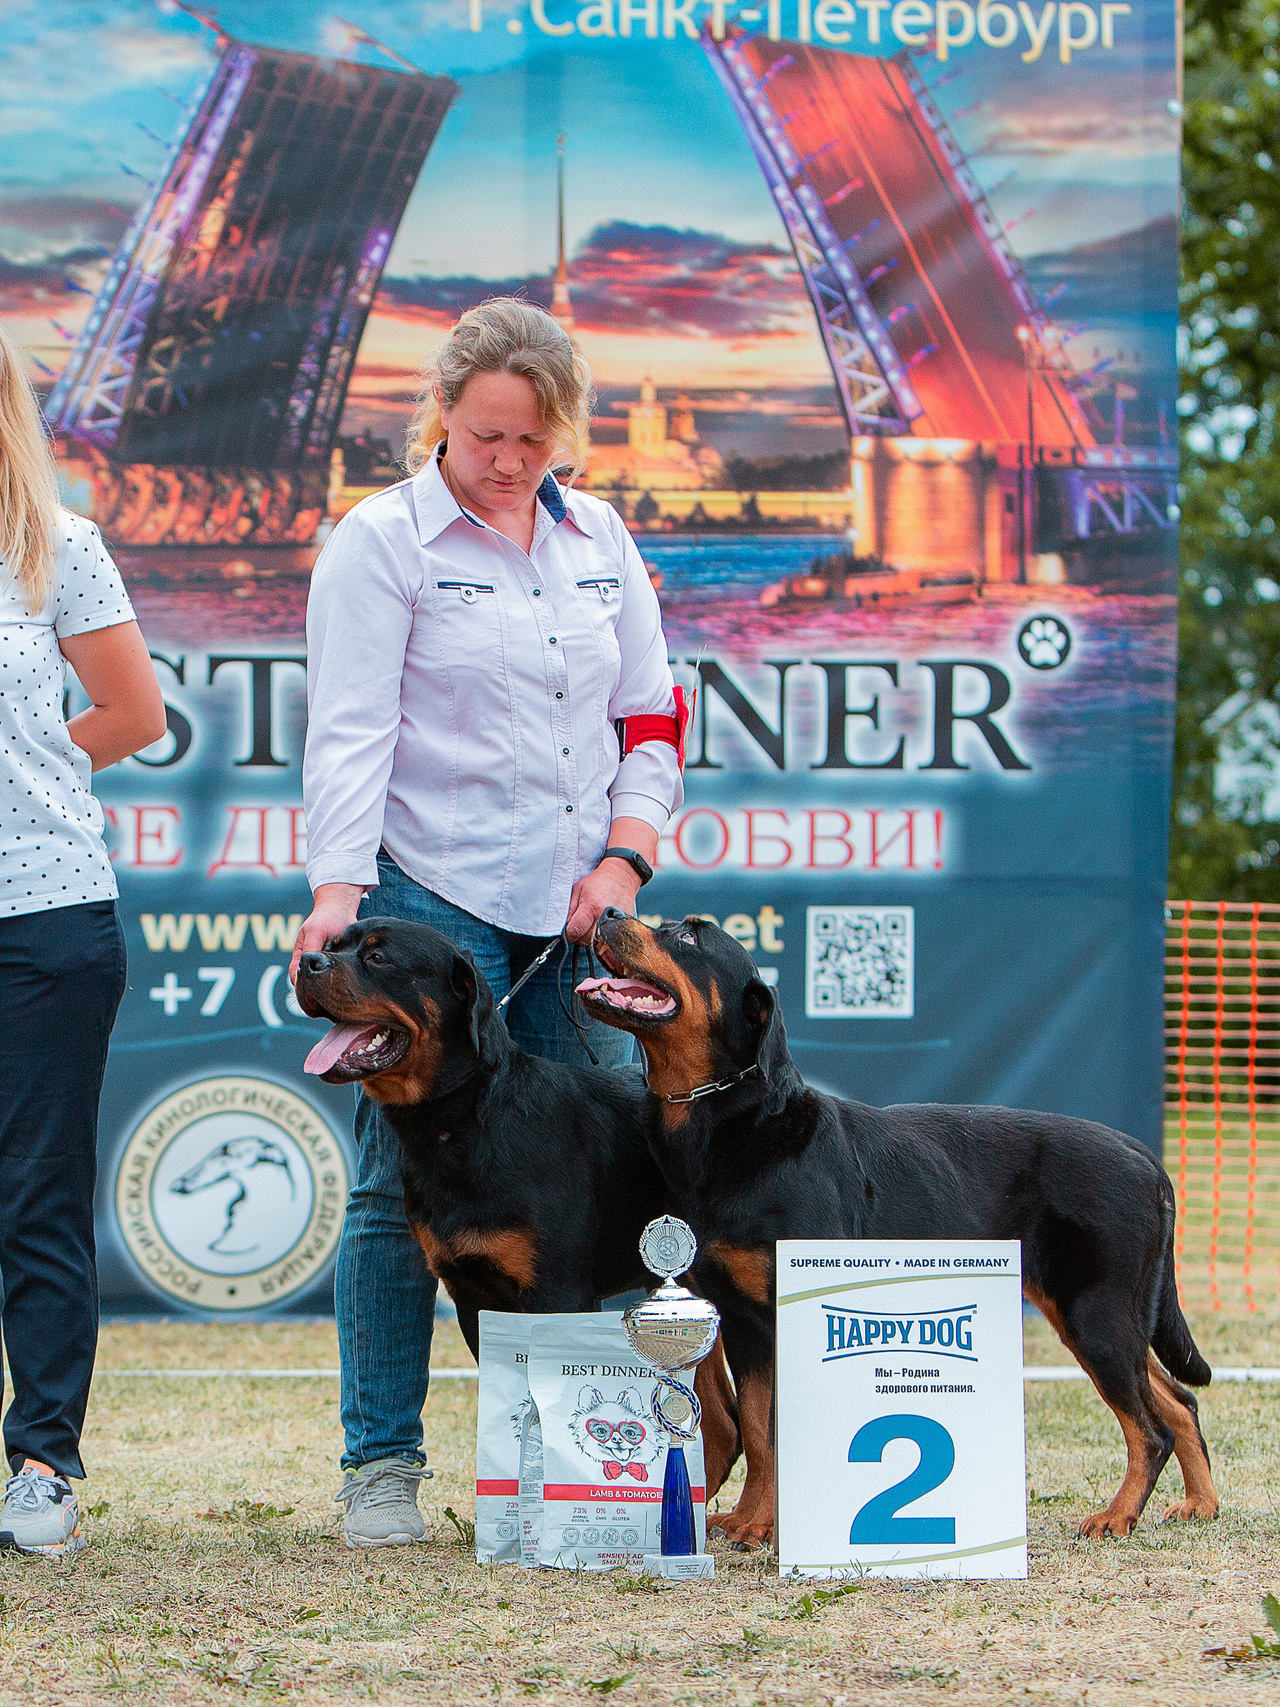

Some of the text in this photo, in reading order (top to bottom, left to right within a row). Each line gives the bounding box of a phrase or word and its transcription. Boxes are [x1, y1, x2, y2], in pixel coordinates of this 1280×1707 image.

[131, 654, 1033, 770] ST NER
[140, 913, 304, 952] www
[149, 971, 236, 1018] +7
[144, 1086, 333, 1164] КИНОЛОГИЧЕСКАЯ
[260, 1170, 340, 1295] ФЕДЕРАЦИЯ
[790, 1258, 1009, 1269] SUPREME QUALITY MADE IN GERMANY
[826, 1313, 973, 1352] HAPPY DOG
[561, 1364, 597, 1376] BEST
[875, 1368, 892, 1378] Мы
[902, 1367, 940, 1379] Родина
[875, 1383, 976, 1395] здорового питания.
[590, 1489, 614, 1498] LAMB
[615, 1490, 621, 1498] &
[848, 1414, 956, 1544] 2
